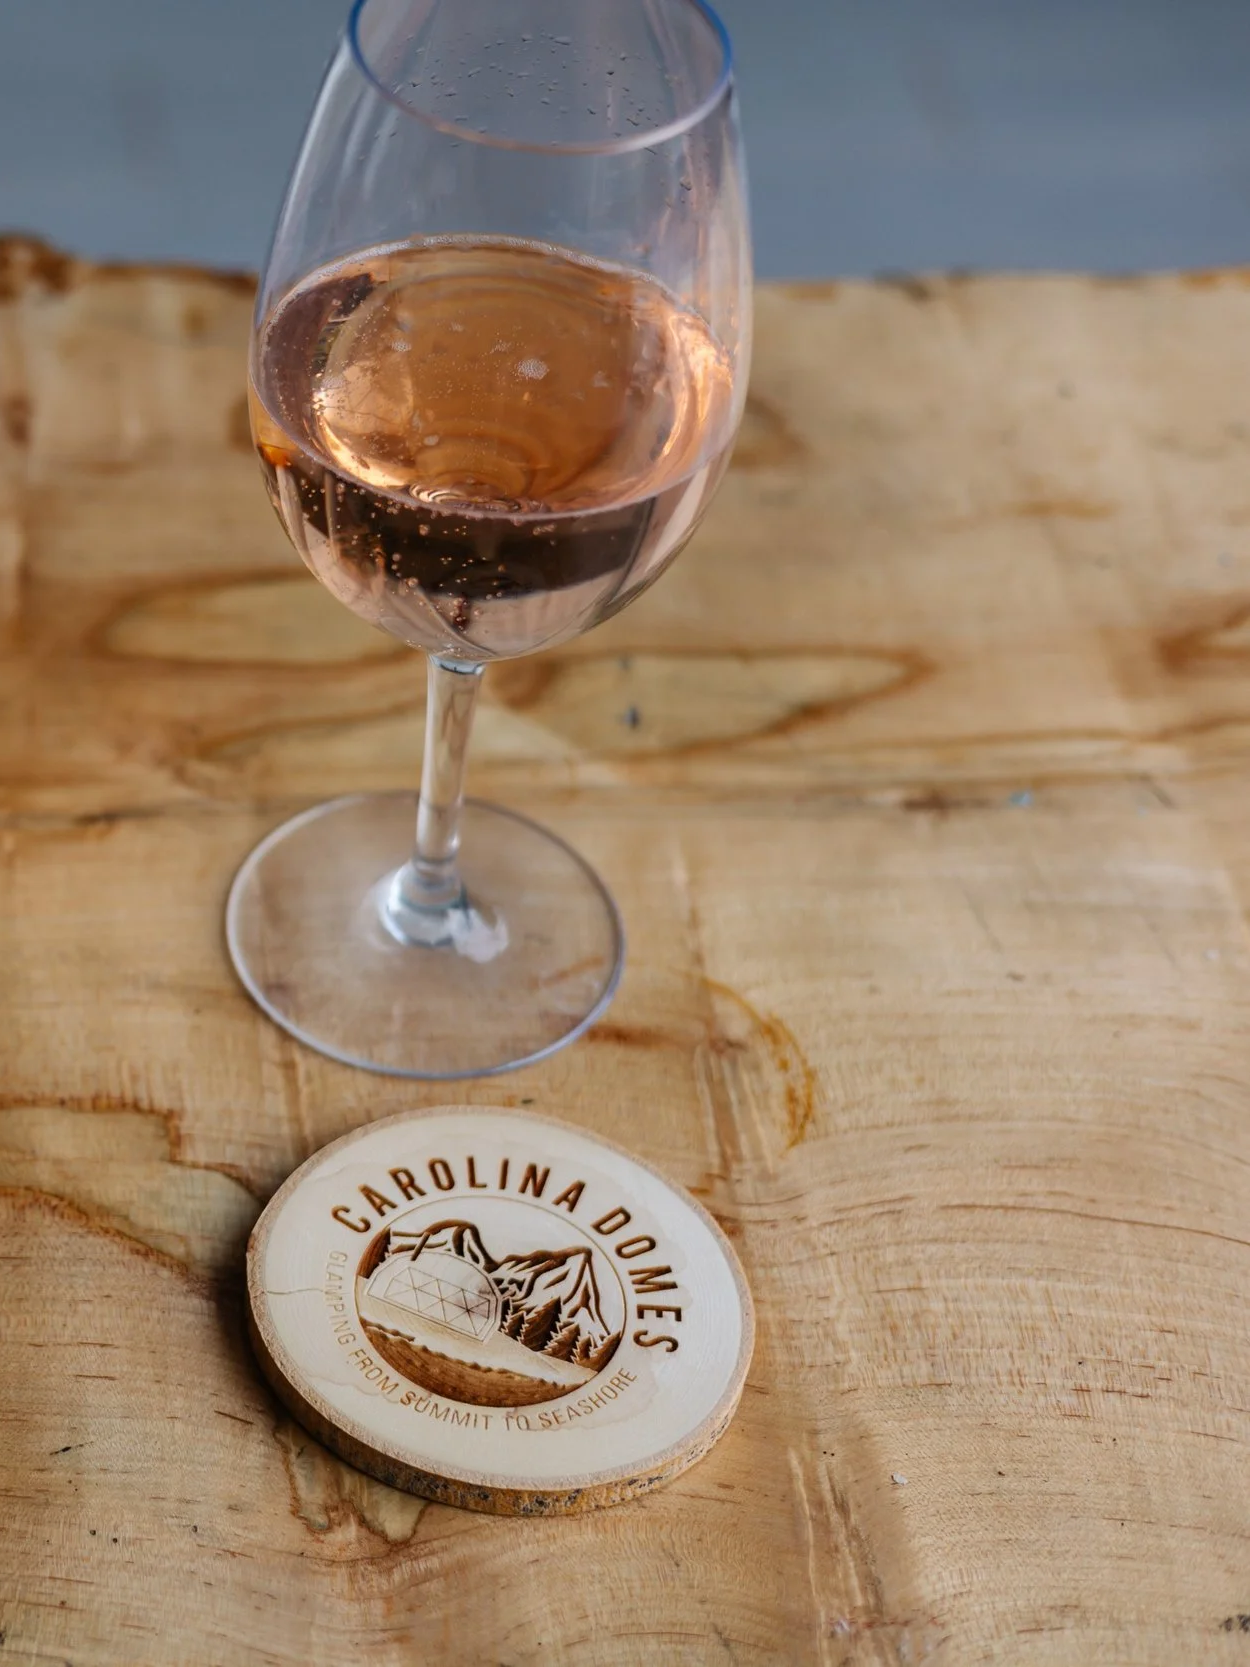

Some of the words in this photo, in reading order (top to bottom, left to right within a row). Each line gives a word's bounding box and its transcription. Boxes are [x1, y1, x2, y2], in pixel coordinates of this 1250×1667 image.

[323, 1249, 357, 1346] GLAMPING
[348, 1349, 400, 1395] FROM
[400, 1389, 494, 1431] SUMMIT
[505, 1414, 531, 1432] TO
[538, 1367, 638, 1428] SEASHORE
[331, 1155, 586, 1234] CAROLINA
[590, 1205, 683, 1353] DOMES
